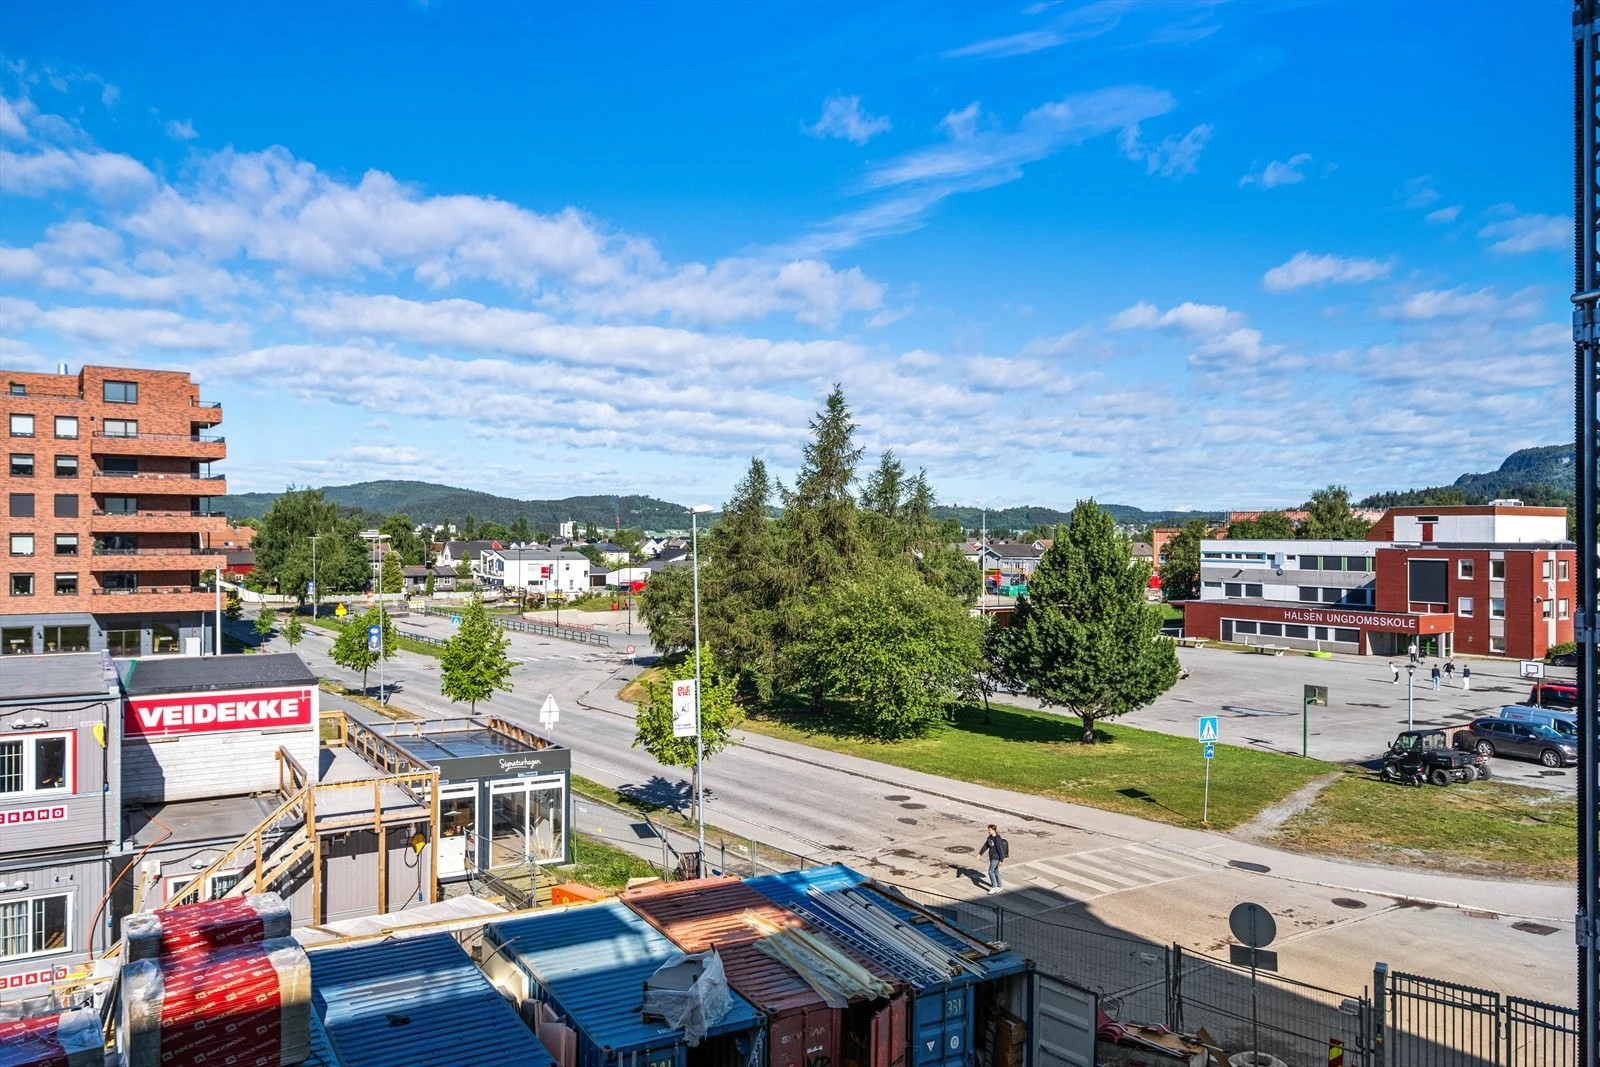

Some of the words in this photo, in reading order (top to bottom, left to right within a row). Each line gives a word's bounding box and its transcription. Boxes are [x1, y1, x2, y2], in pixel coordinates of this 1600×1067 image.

[1284, 611, 1322, 621] HALSEN
[1327, 613, 1416, 628] UNGDOMSSKOLE
[138, 698, 299, 728] VEIDEKKE
[498, 757, 541, 772] Signaturhagen
[946, 998, 961, 1017] 331
